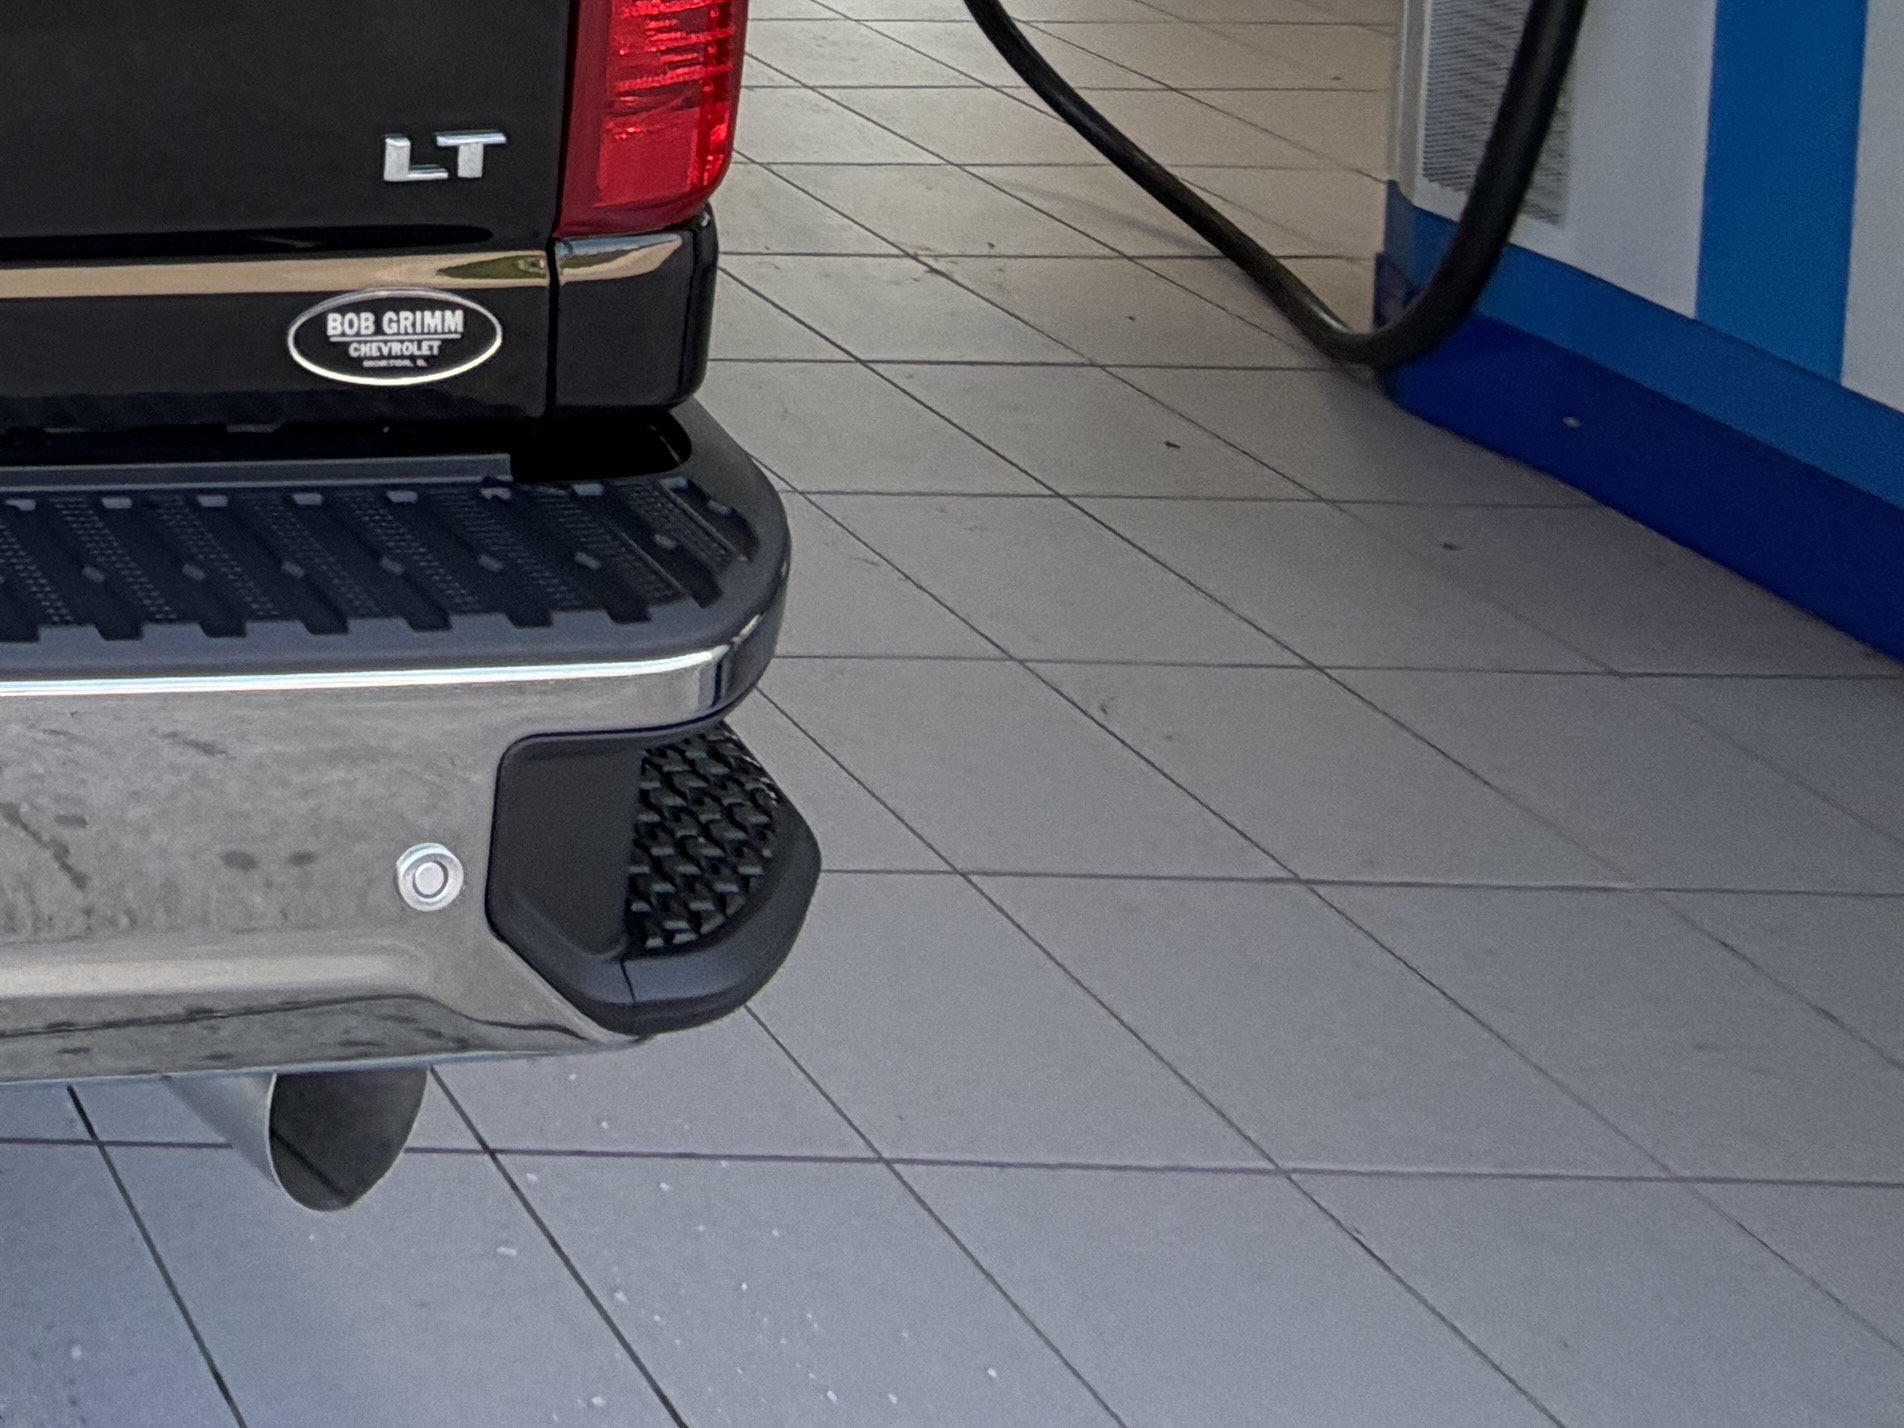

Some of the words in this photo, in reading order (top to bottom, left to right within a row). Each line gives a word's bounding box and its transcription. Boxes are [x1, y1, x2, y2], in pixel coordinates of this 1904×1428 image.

[382, 128, 508, 183] LT
[326, 311, 376, 337] BOB
[382, 309, 465, 335] GRIMM
[348, 340, 442, 358] CHEVROLET
